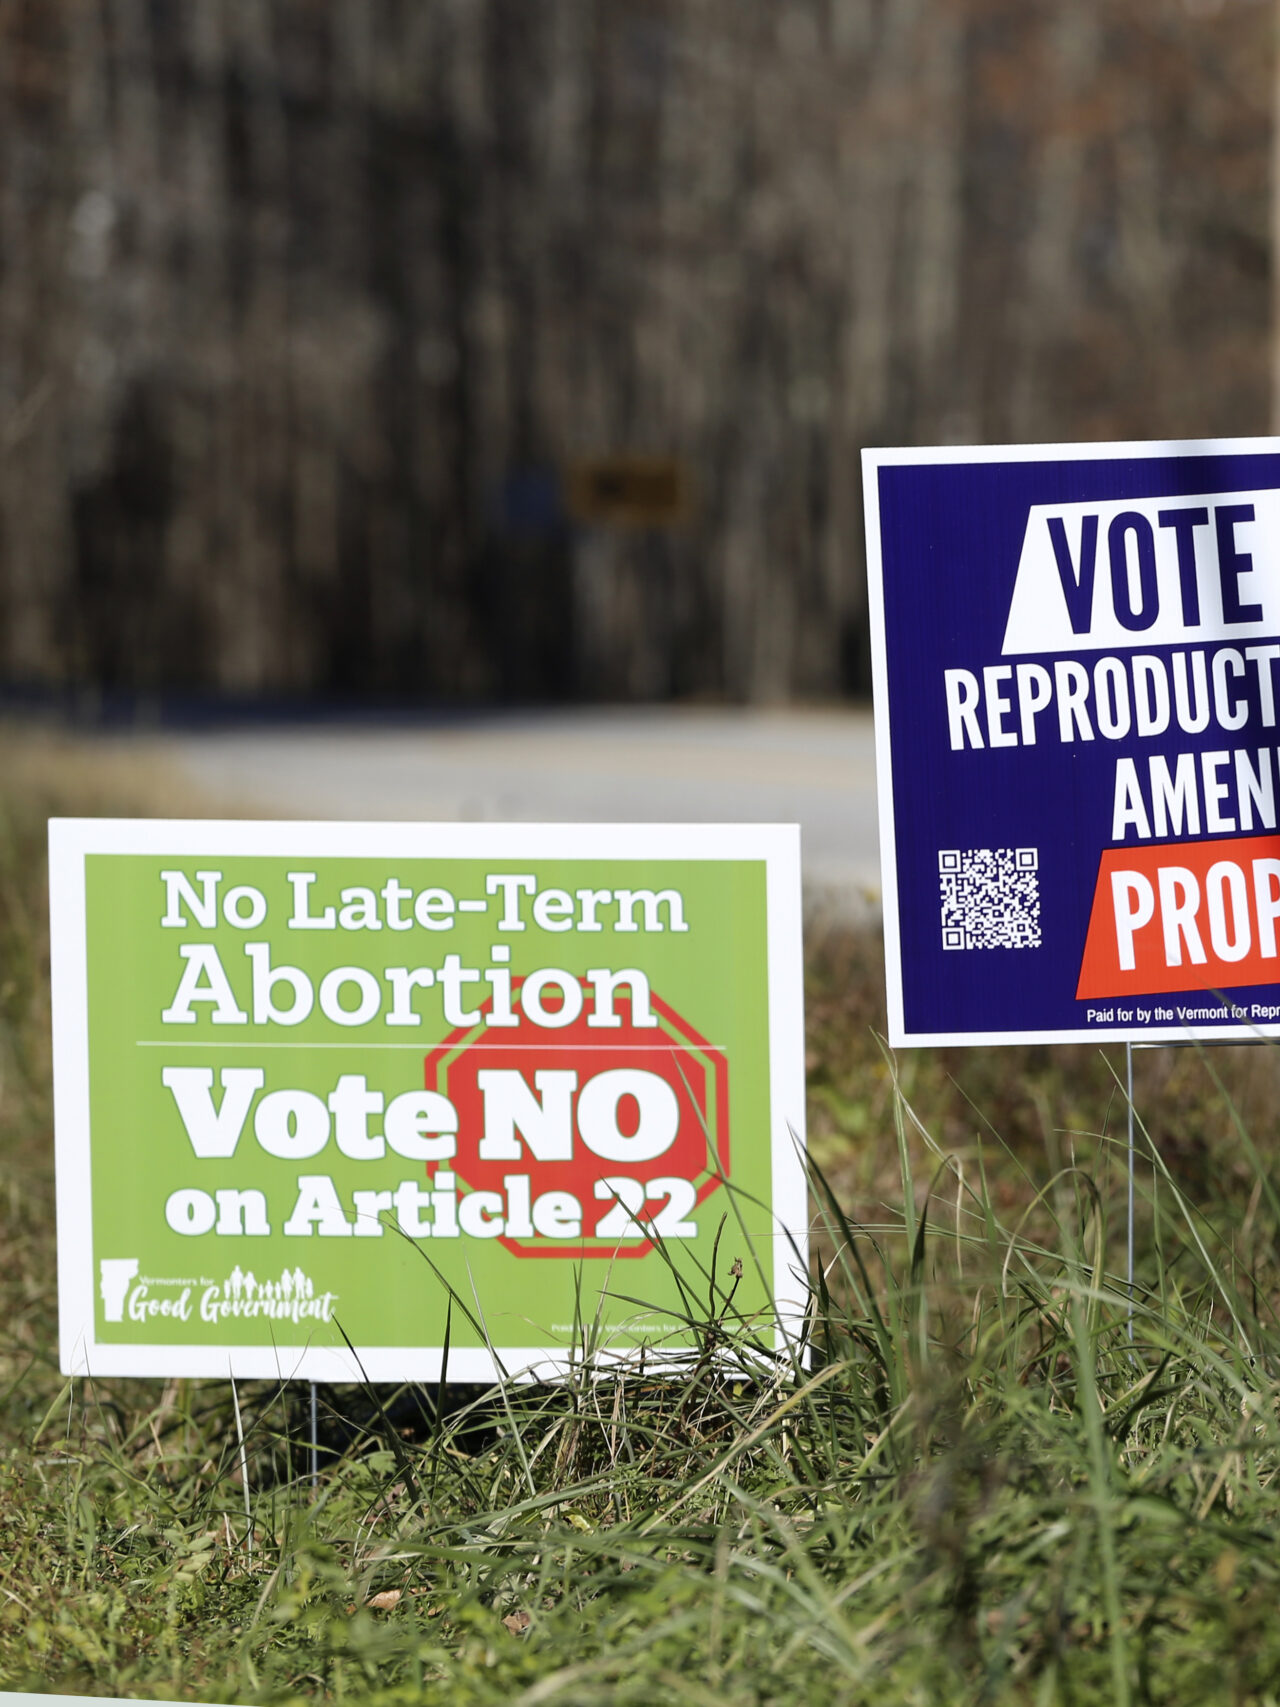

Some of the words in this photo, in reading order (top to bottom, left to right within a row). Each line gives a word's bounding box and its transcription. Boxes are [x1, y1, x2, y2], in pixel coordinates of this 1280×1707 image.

[1047, 503, 1264, 635] VOTE
[160, 870, 267, 929] No
[287, 872, 689, 932] Late-Term
[161, 942, 658, 1028] Abortion
[1087, 1008, 1114, 1022] Paid
[1117, 1007, 1133, 1021] for
[1137, 1007, 1151, 1024] by
[1154, 1006, 1174, 1020] the
[1176, 1005, 1229, 1020] Vermont
[1231, 1004, 1249, 1018] for
[162, 1066, 460, 1161] Vote
[478, 1068, 679, 1162] NO
[165, 1188, 271, 1237] on
[284, 1171, 582, 1238] Article
[594, 1177, 698, 1238] 22
[129, 1285, 193, 1324] Good
[200, 1285, 339, 1324] Government
[138, 1275, 197, 1287] Vermonters
[200, 1275, 214, 1287] for
